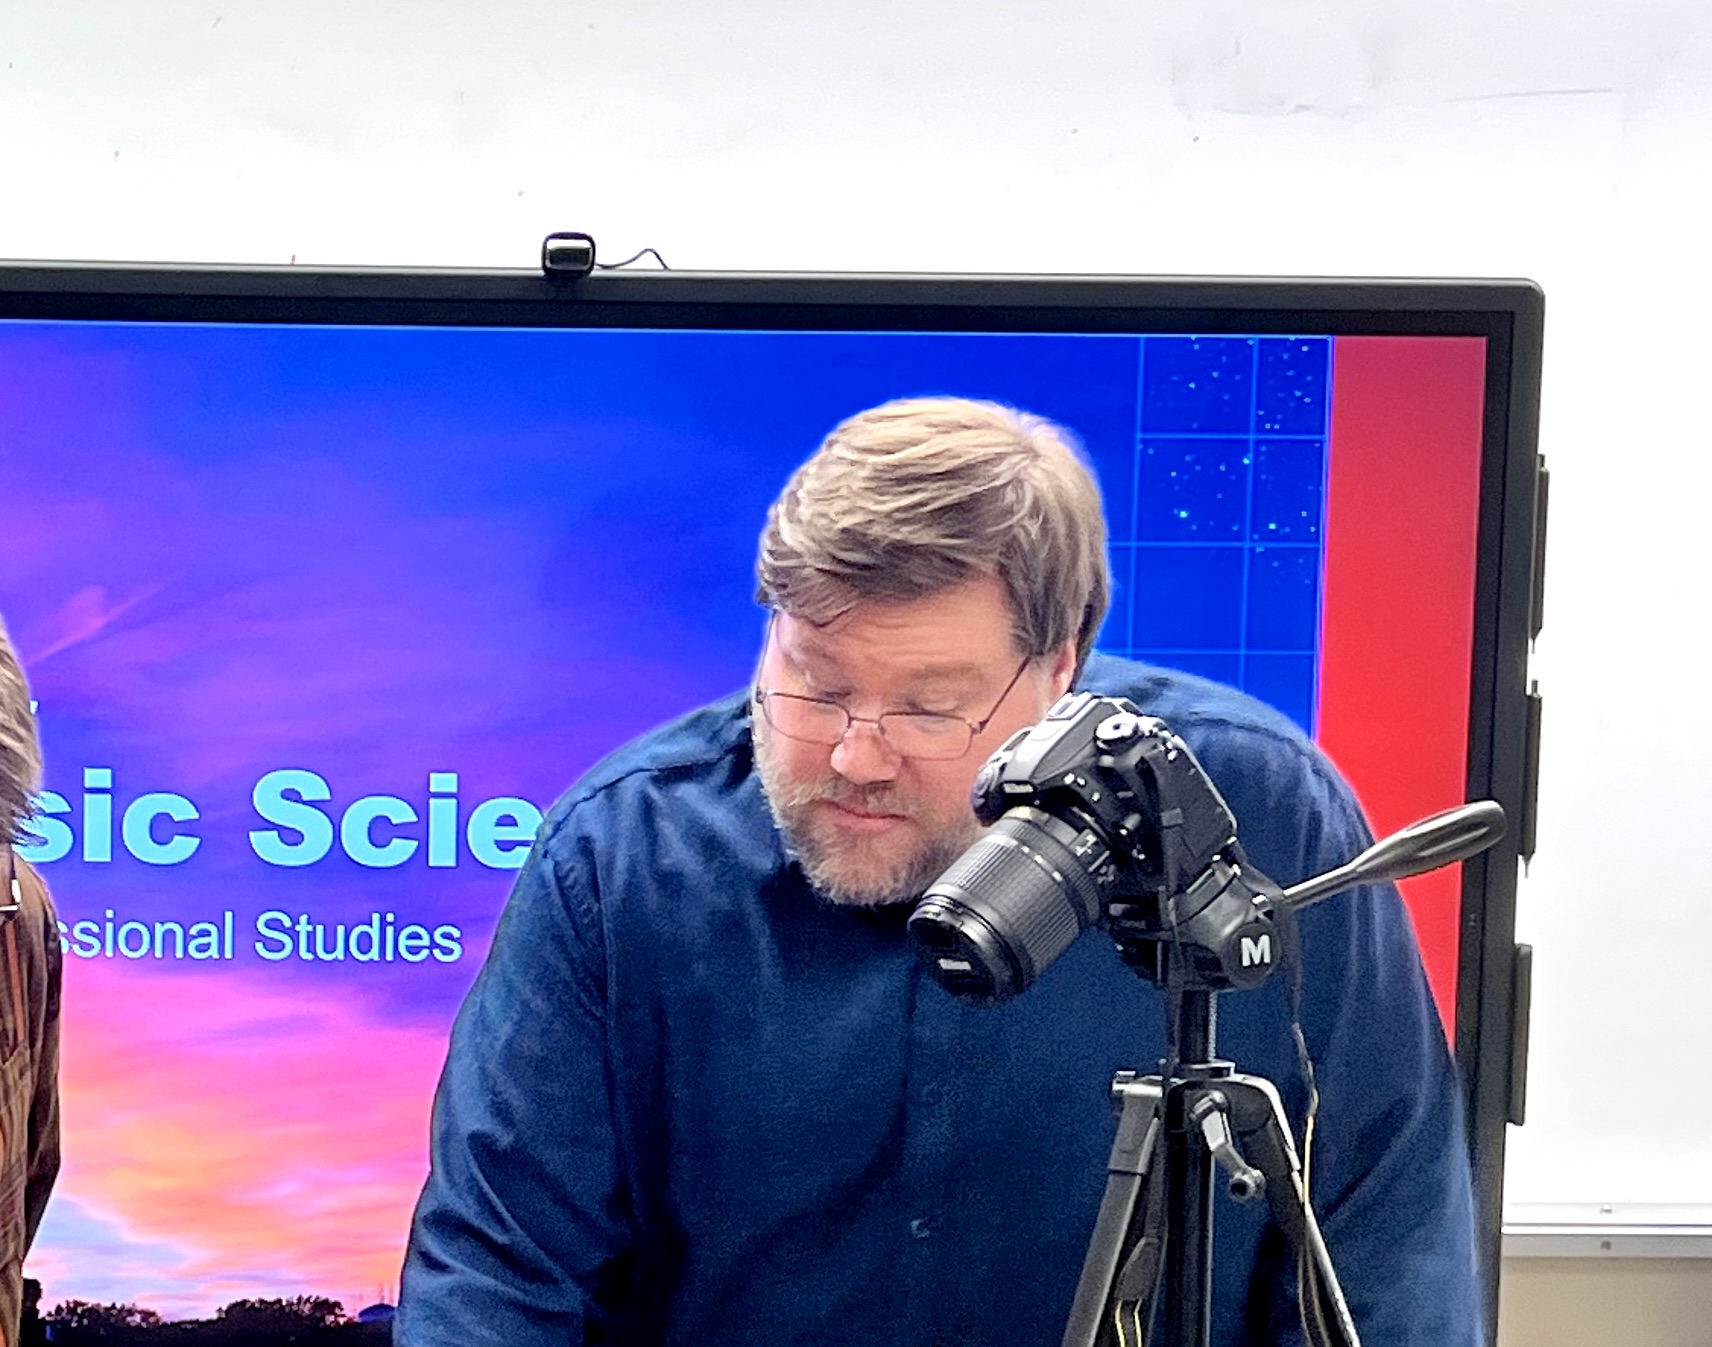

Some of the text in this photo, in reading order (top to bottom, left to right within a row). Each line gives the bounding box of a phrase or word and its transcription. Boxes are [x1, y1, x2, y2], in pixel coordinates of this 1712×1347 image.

[248, 769, 545, 868] Scie
[254, 910, 464, 962] Studies
[1240, 933, 1271, 967] M
